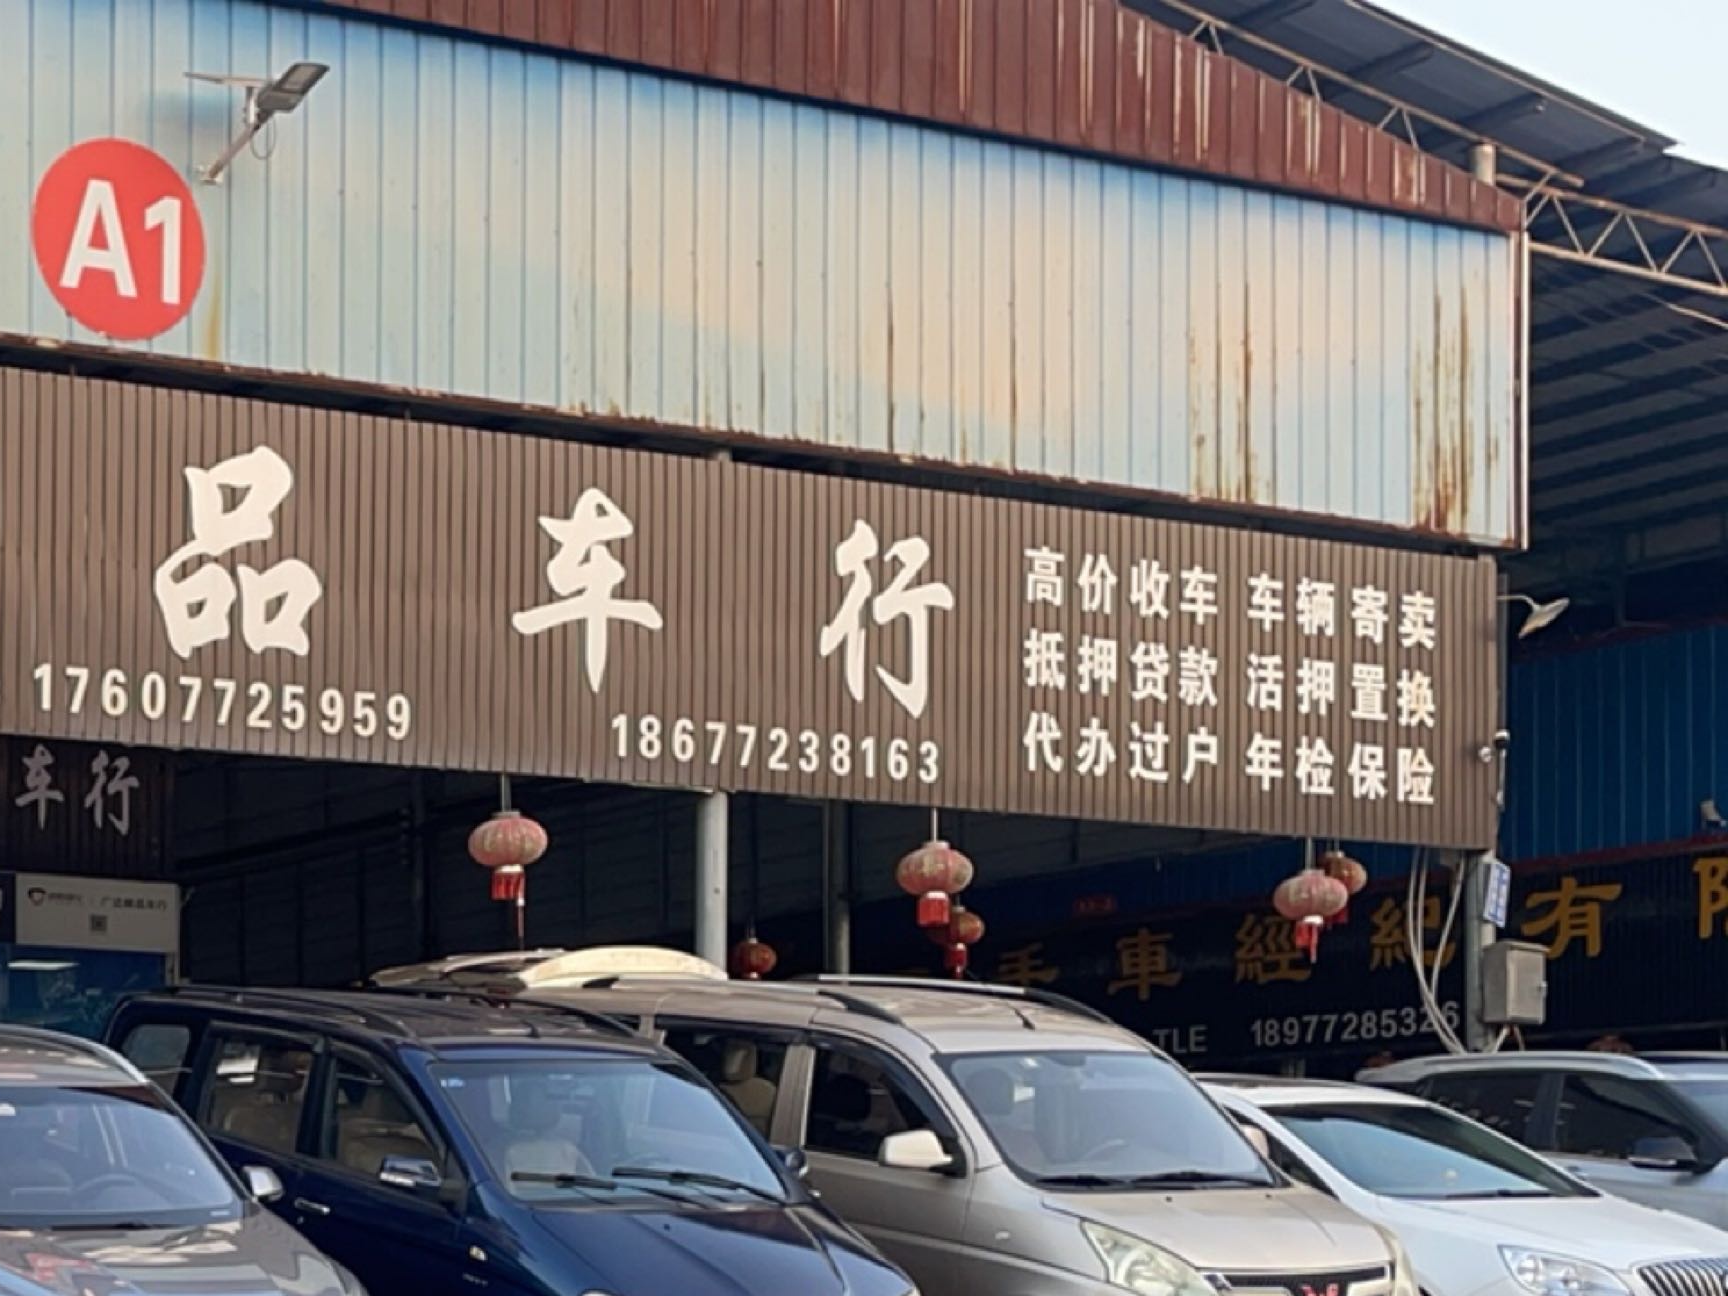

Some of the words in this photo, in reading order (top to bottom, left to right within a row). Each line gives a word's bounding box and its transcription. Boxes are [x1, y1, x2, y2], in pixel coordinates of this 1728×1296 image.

[59, 177, 182, 305] A1
[1023, 546, 1219, 625] 高价收车
[1246, 572, 1436, 649] 车辆寄卖
[34, 662, 411, 741] 17607725959
[1023, 627, 1218, 707] 抵押贷款
[1246, 652, 1436, 728] 活押置换
[611, 713, 940, 784] 18677238163
[1022, 712, 1219, 784] 代办过户
[1245, 731, 1435, 806] 年检保险
[1251, 1000, 1461, 1047] 18977285326
